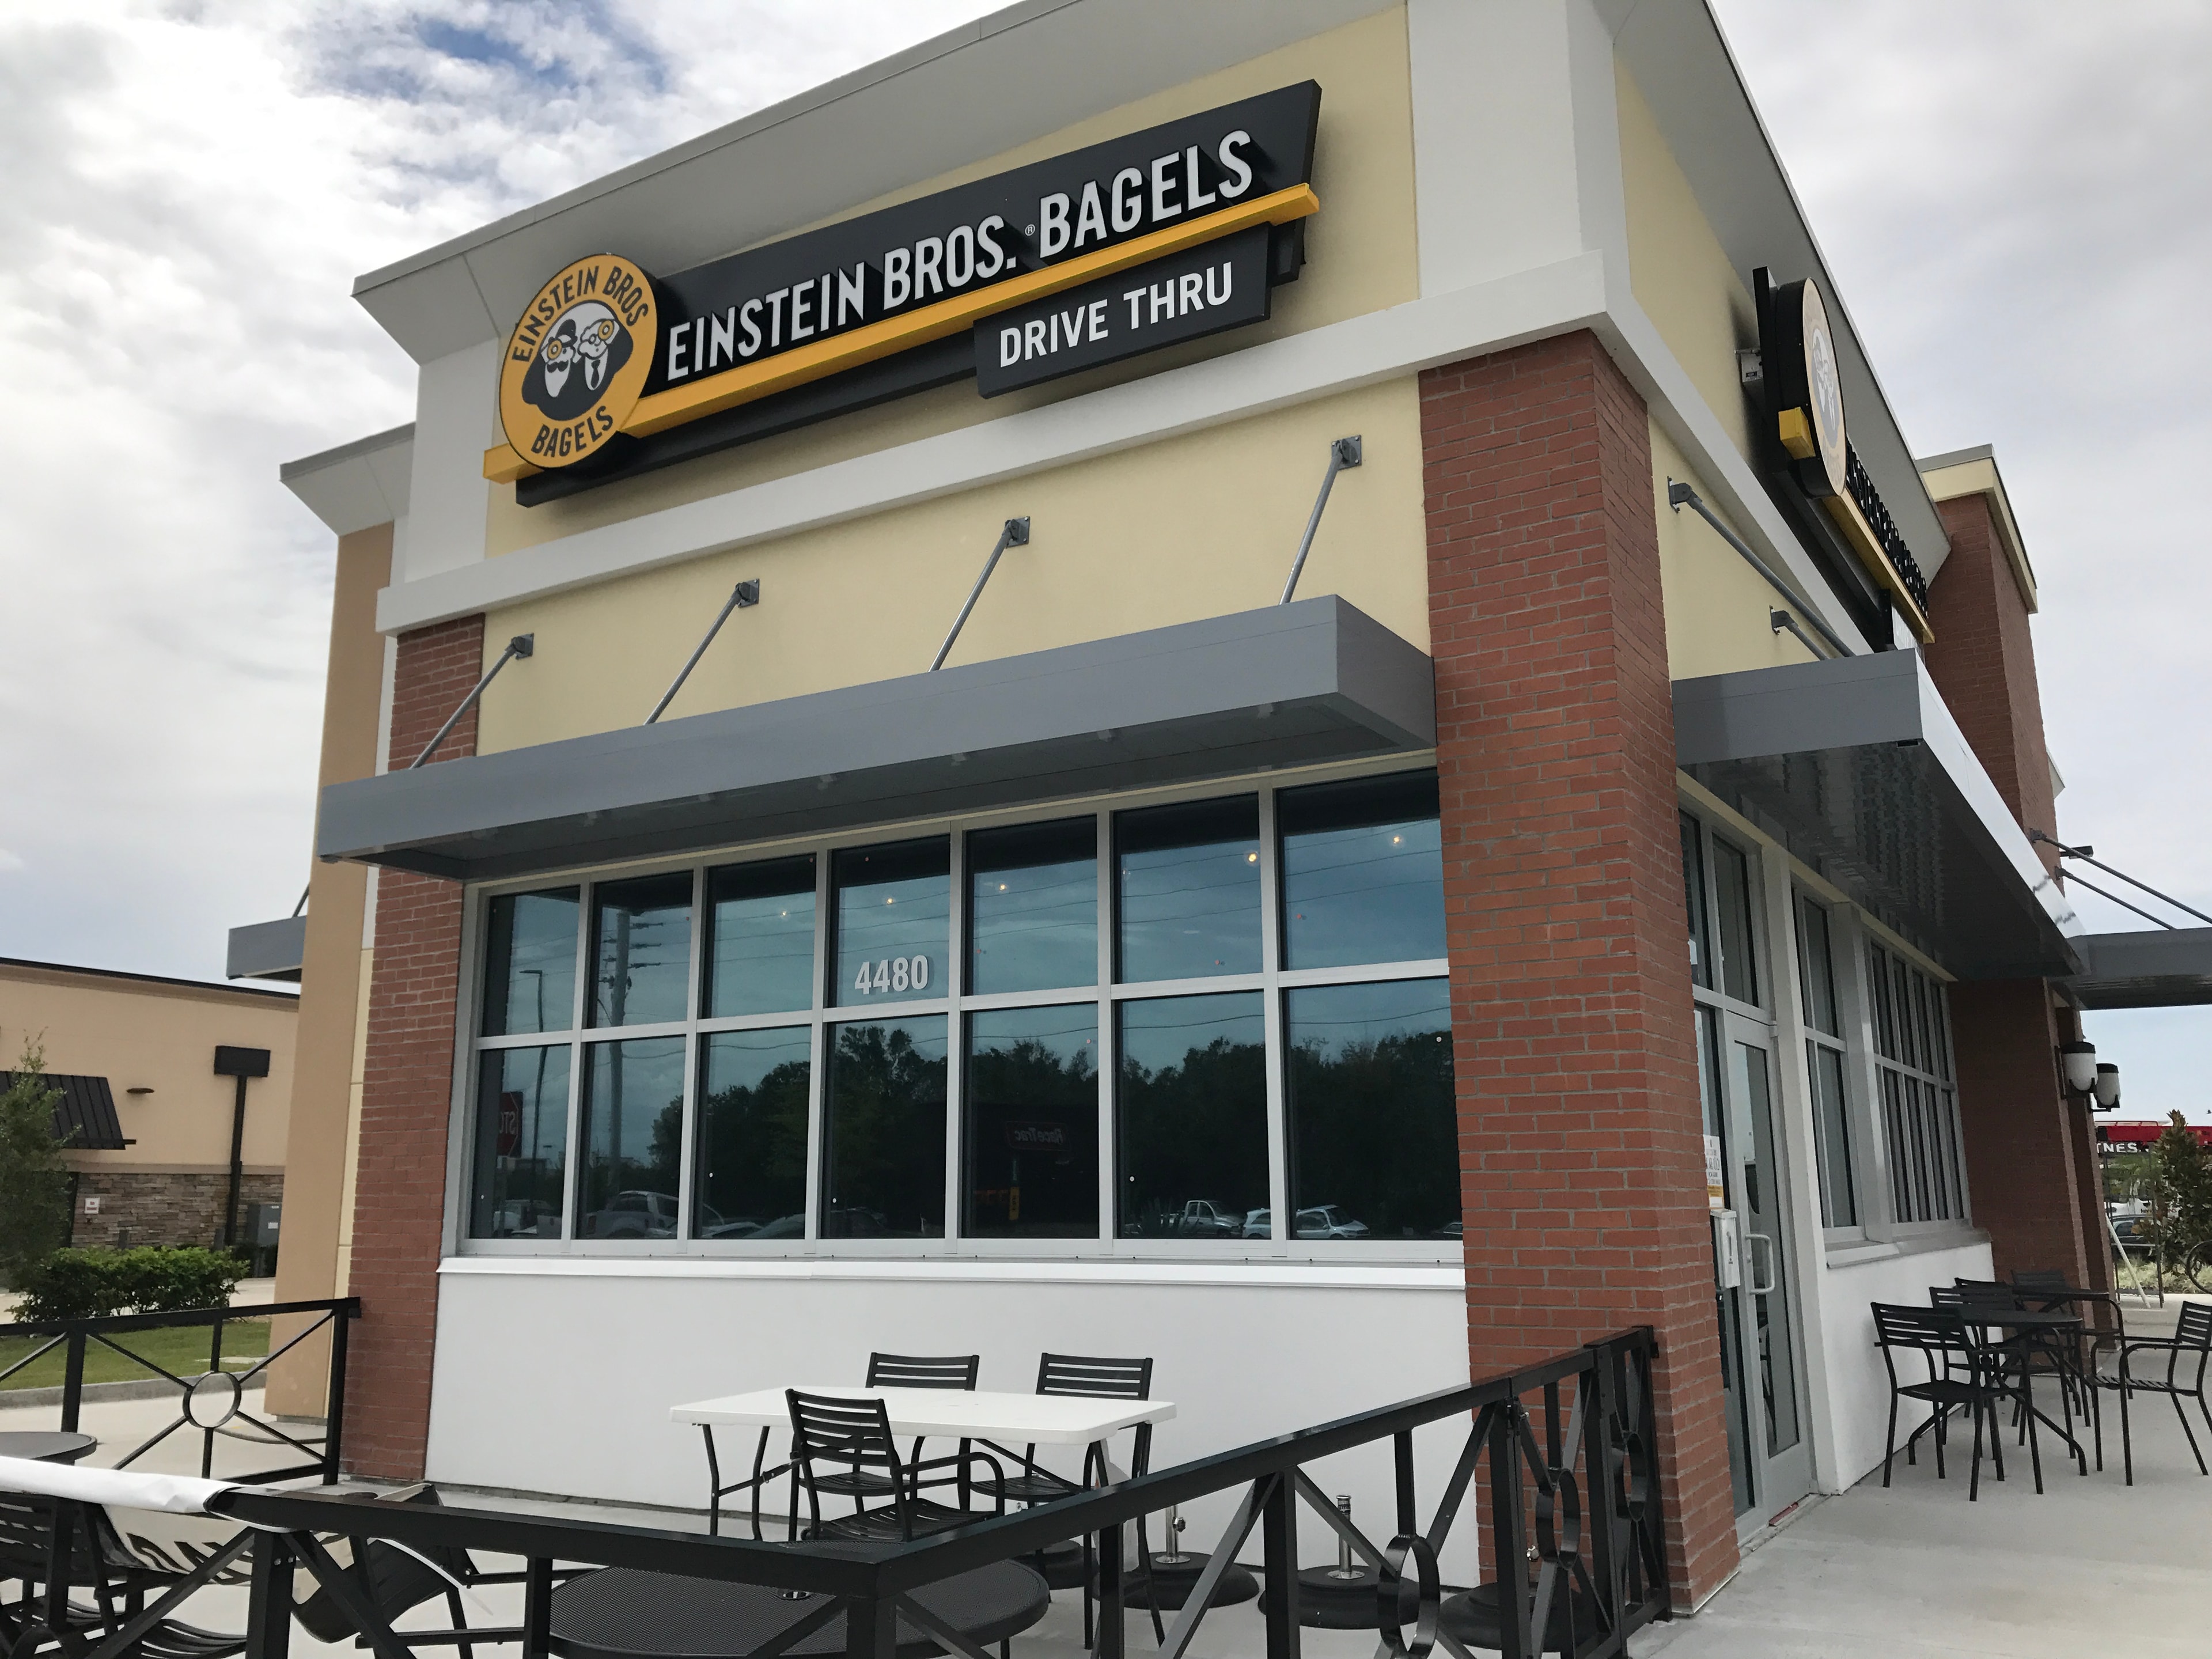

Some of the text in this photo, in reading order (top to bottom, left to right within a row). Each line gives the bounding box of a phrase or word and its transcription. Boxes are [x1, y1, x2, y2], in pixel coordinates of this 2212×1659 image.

[667, 130, 1252, 381] EINSTEIN BROS. BAGELS
[512, 265, 649, 363] EINSTEIN BROS
[999, 261, 1233, 368] DRIVE THRU
[531, 404, 614, 458] BAGELS
[854, 955, 929, 995] 4480
